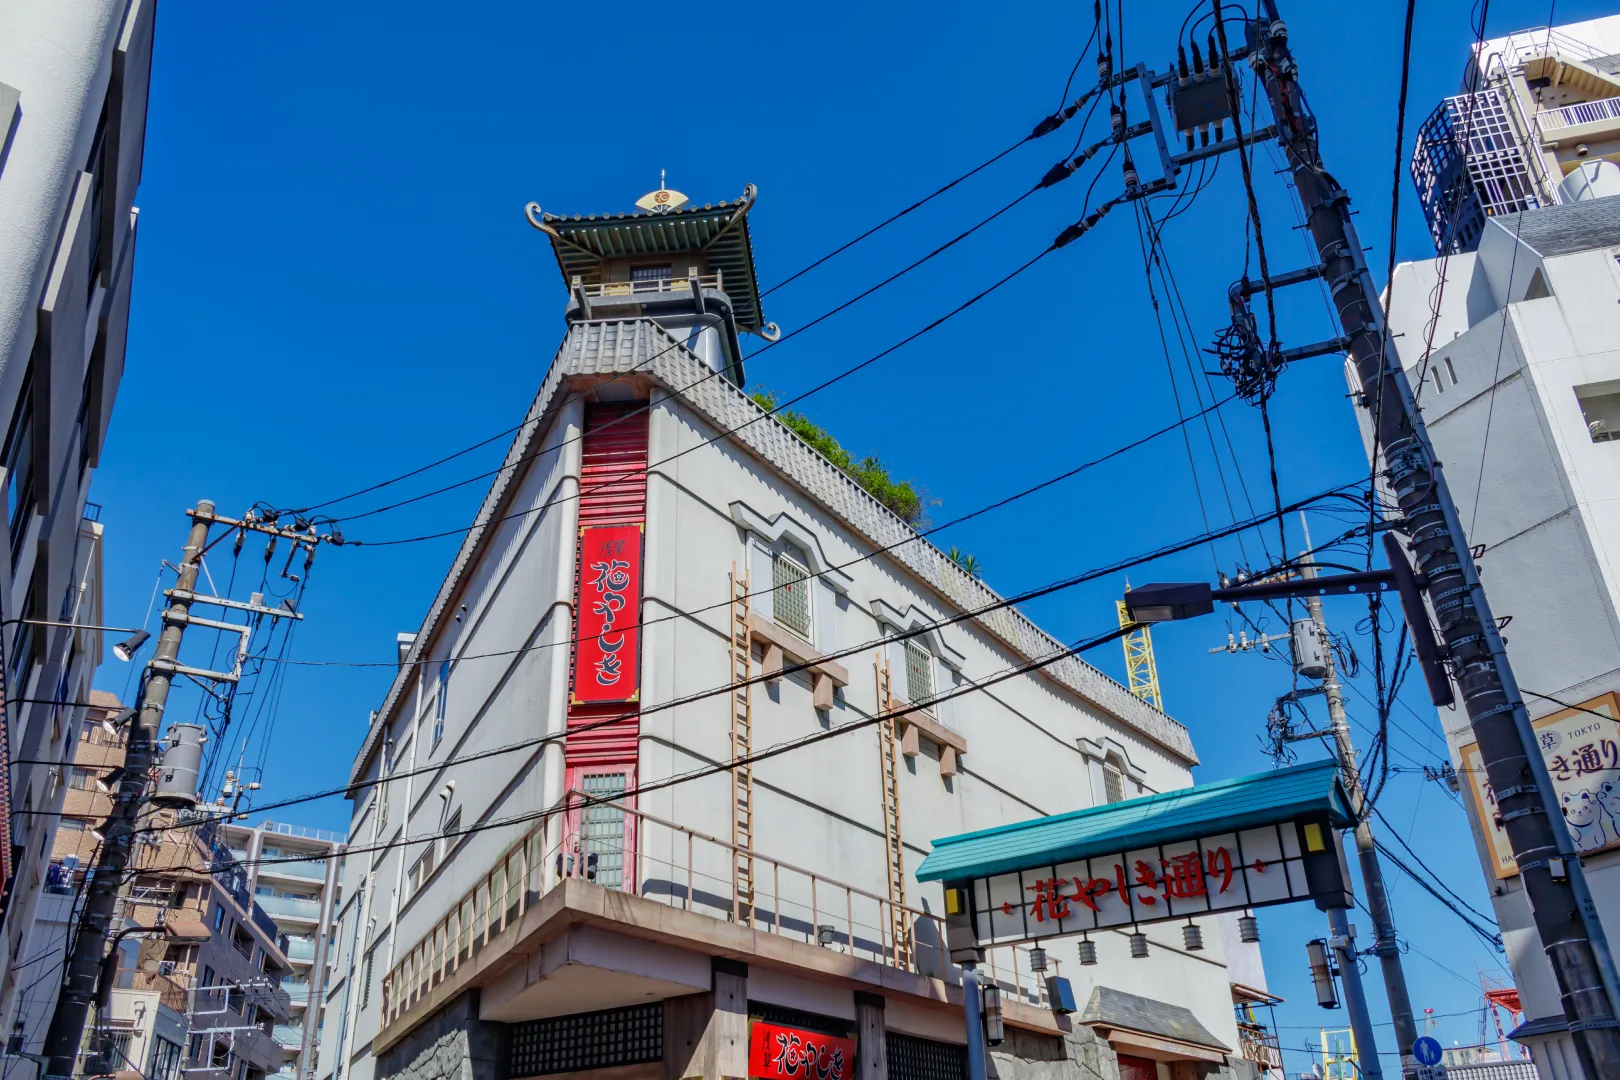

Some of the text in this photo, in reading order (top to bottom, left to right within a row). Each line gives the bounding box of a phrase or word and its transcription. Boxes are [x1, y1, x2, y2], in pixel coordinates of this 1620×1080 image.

[587, 559, 630, 686] 花やしき
[1539, 732, 1557, 750] 草
[1567, 722, 1601, 740] TOKYO
[1551, 739, 1618, 782] き通り
[1025, 846, 1234, 923] 花やしき通り
[772, 1031, 845, 1080] 花やしき
